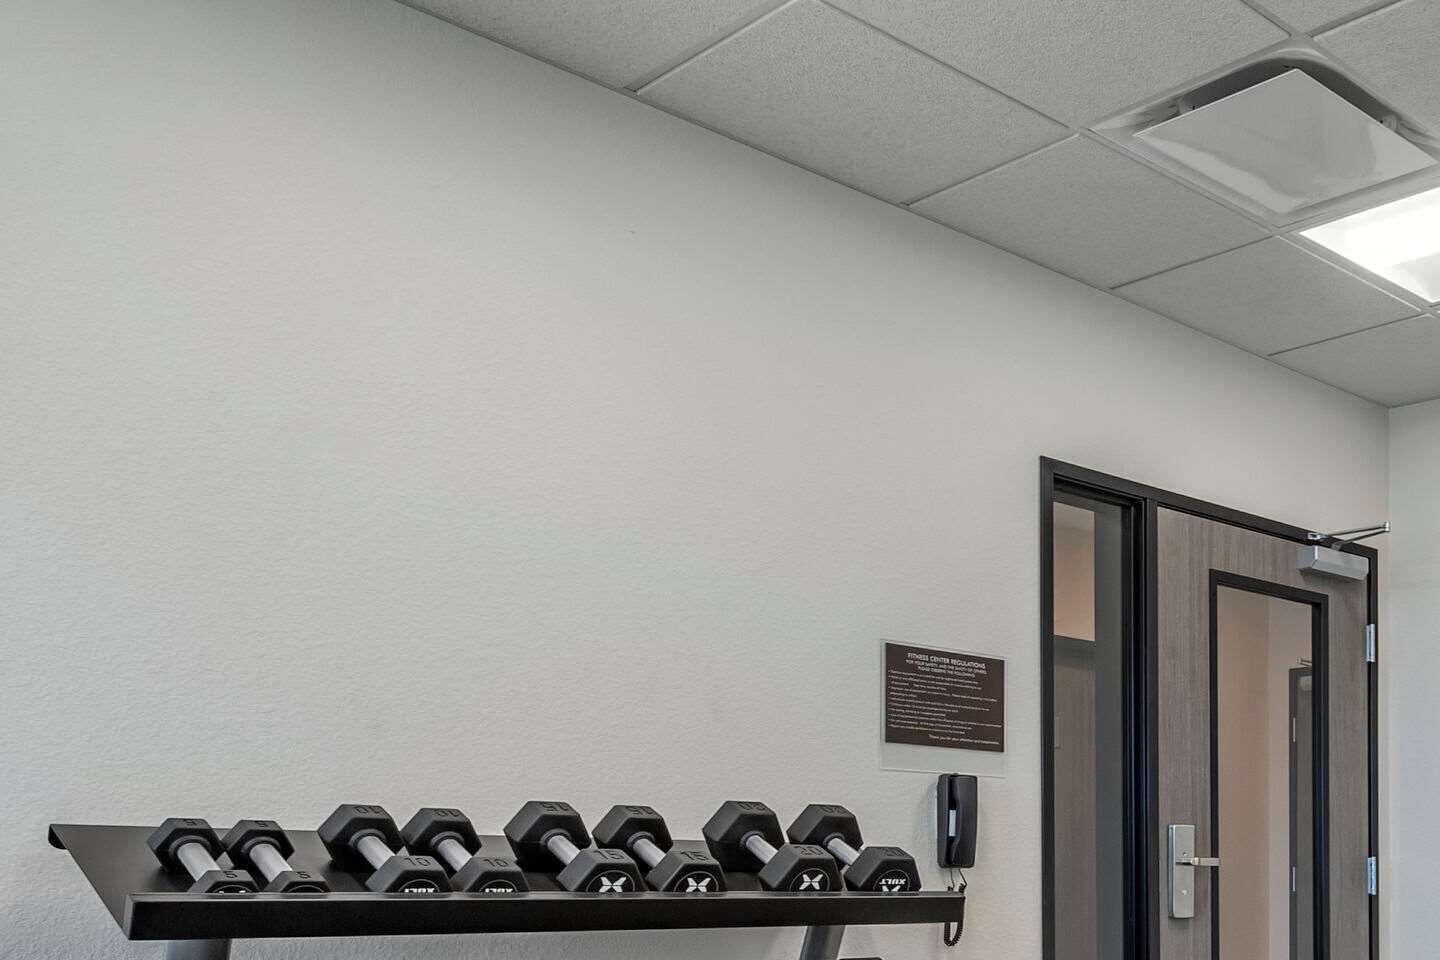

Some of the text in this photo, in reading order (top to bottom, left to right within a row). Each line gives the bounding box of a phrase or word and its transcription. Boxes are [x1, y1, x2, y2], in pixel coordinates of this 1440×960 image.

[907, 652, 986, 669] FITNESS CENTER REGULATIONS
